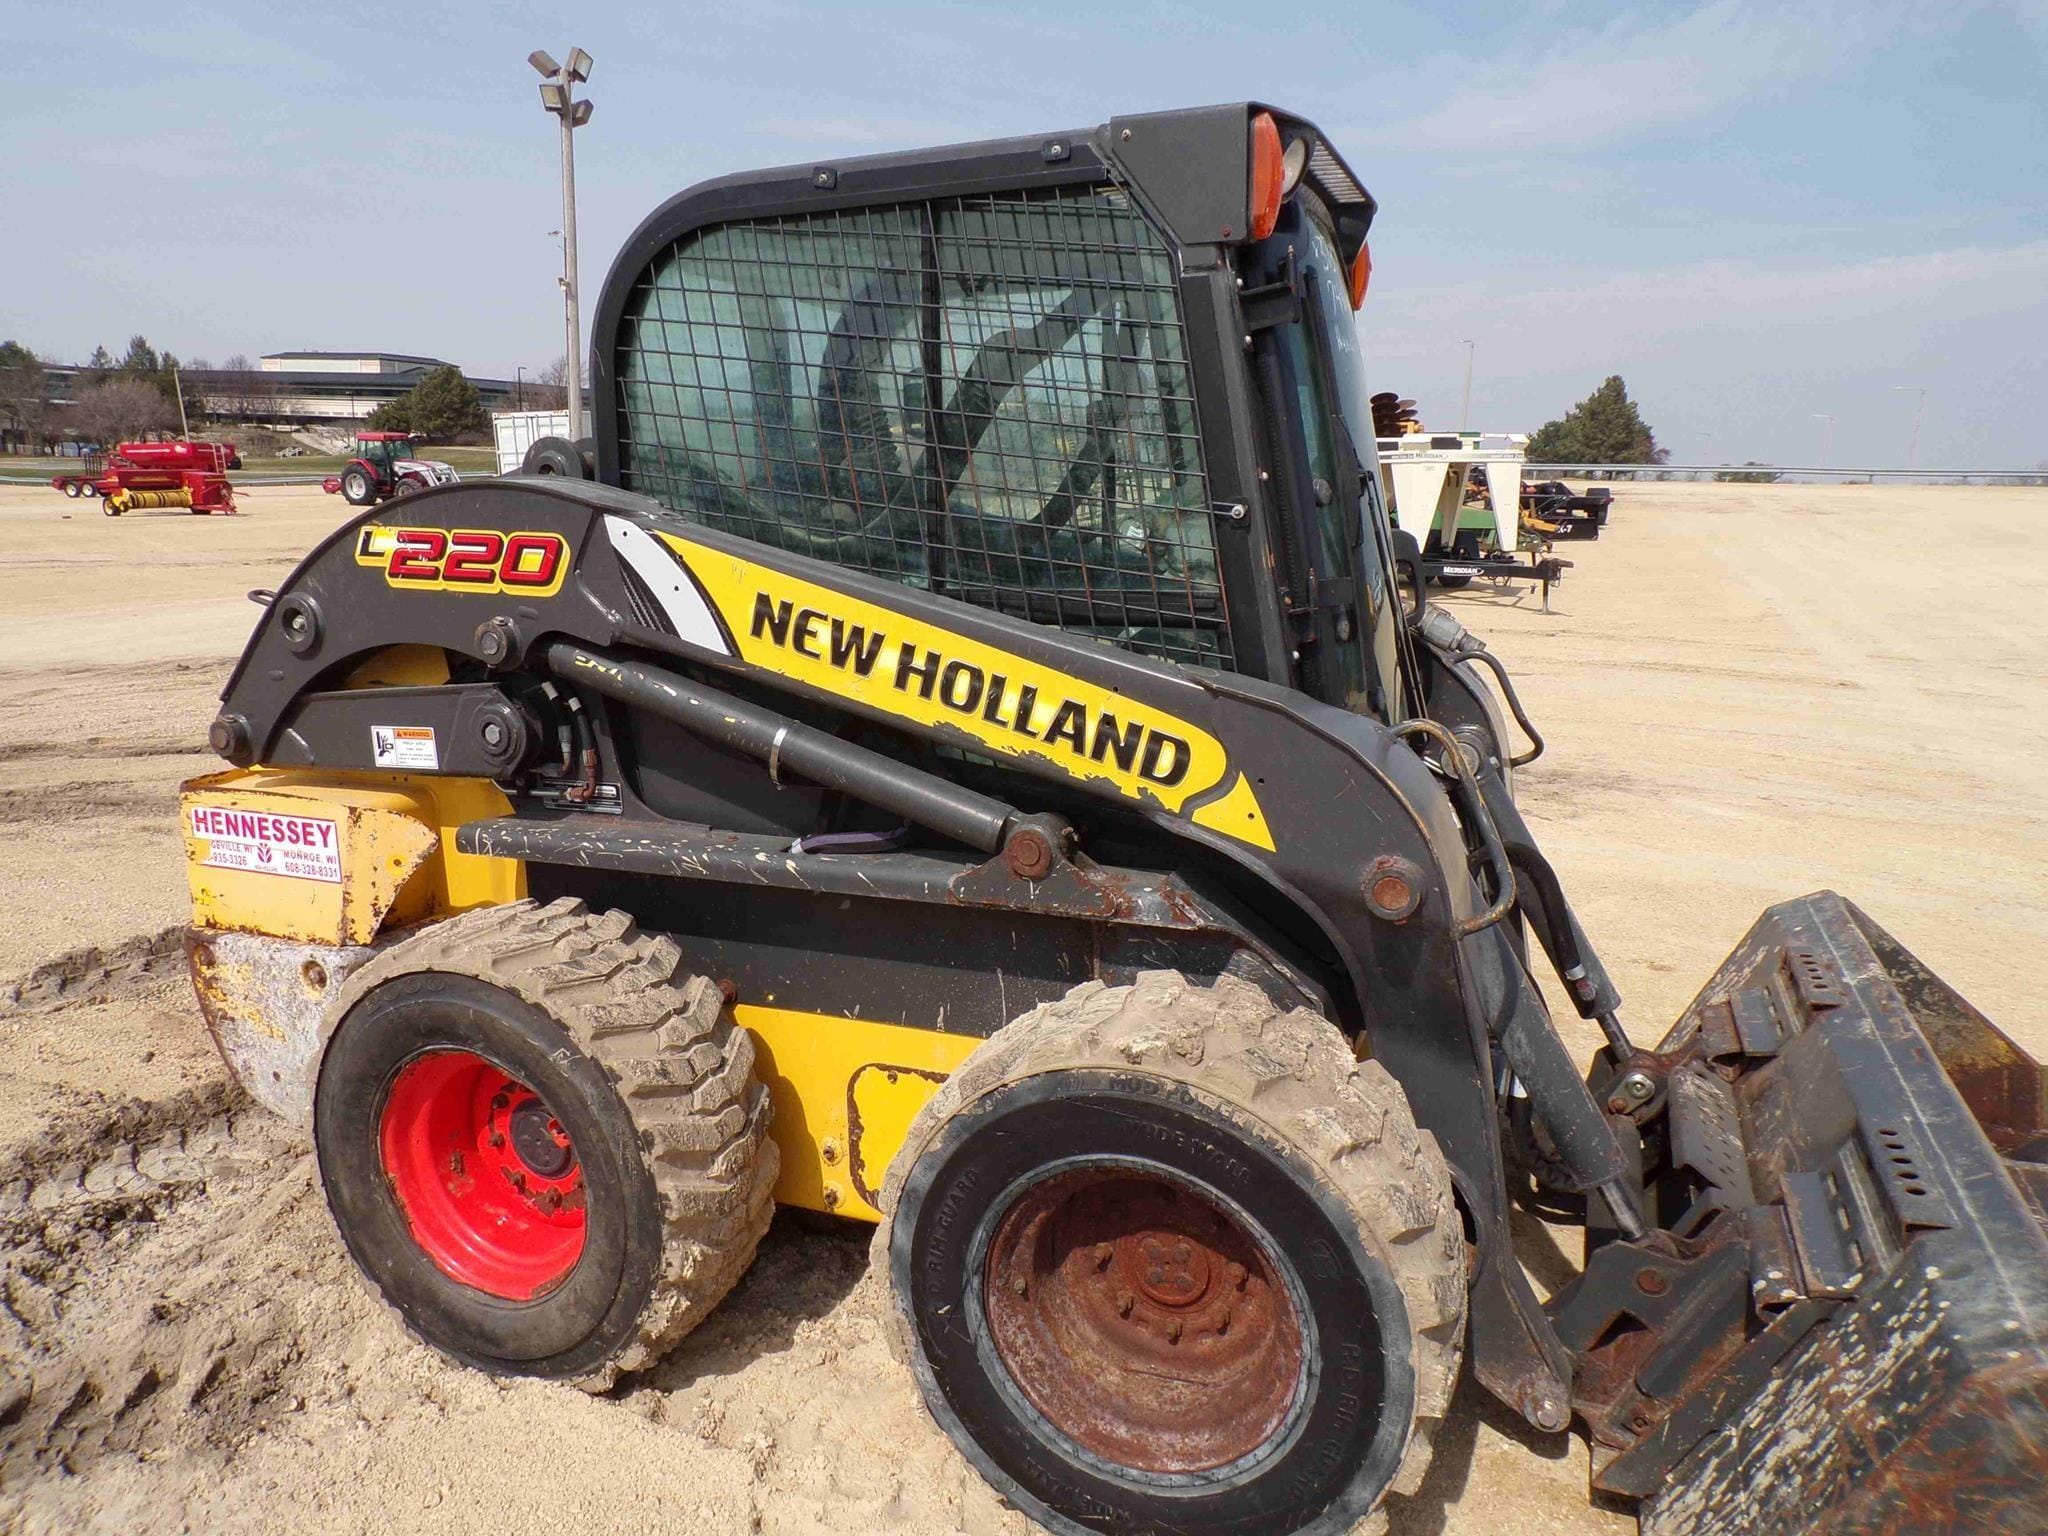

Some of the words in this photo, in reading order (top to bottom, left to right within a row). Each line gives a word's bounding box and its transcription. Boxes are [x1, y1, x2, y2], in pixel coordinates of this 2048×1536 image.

[357, 528, 562, 590] L220
[1443, 566, 1479, 575] MERIDIAN
[749, 591, 886, 678] NEW
[893, 641, 1193, 788] HOLLAND
[194, 809, 332, 848] HENNESSEY
